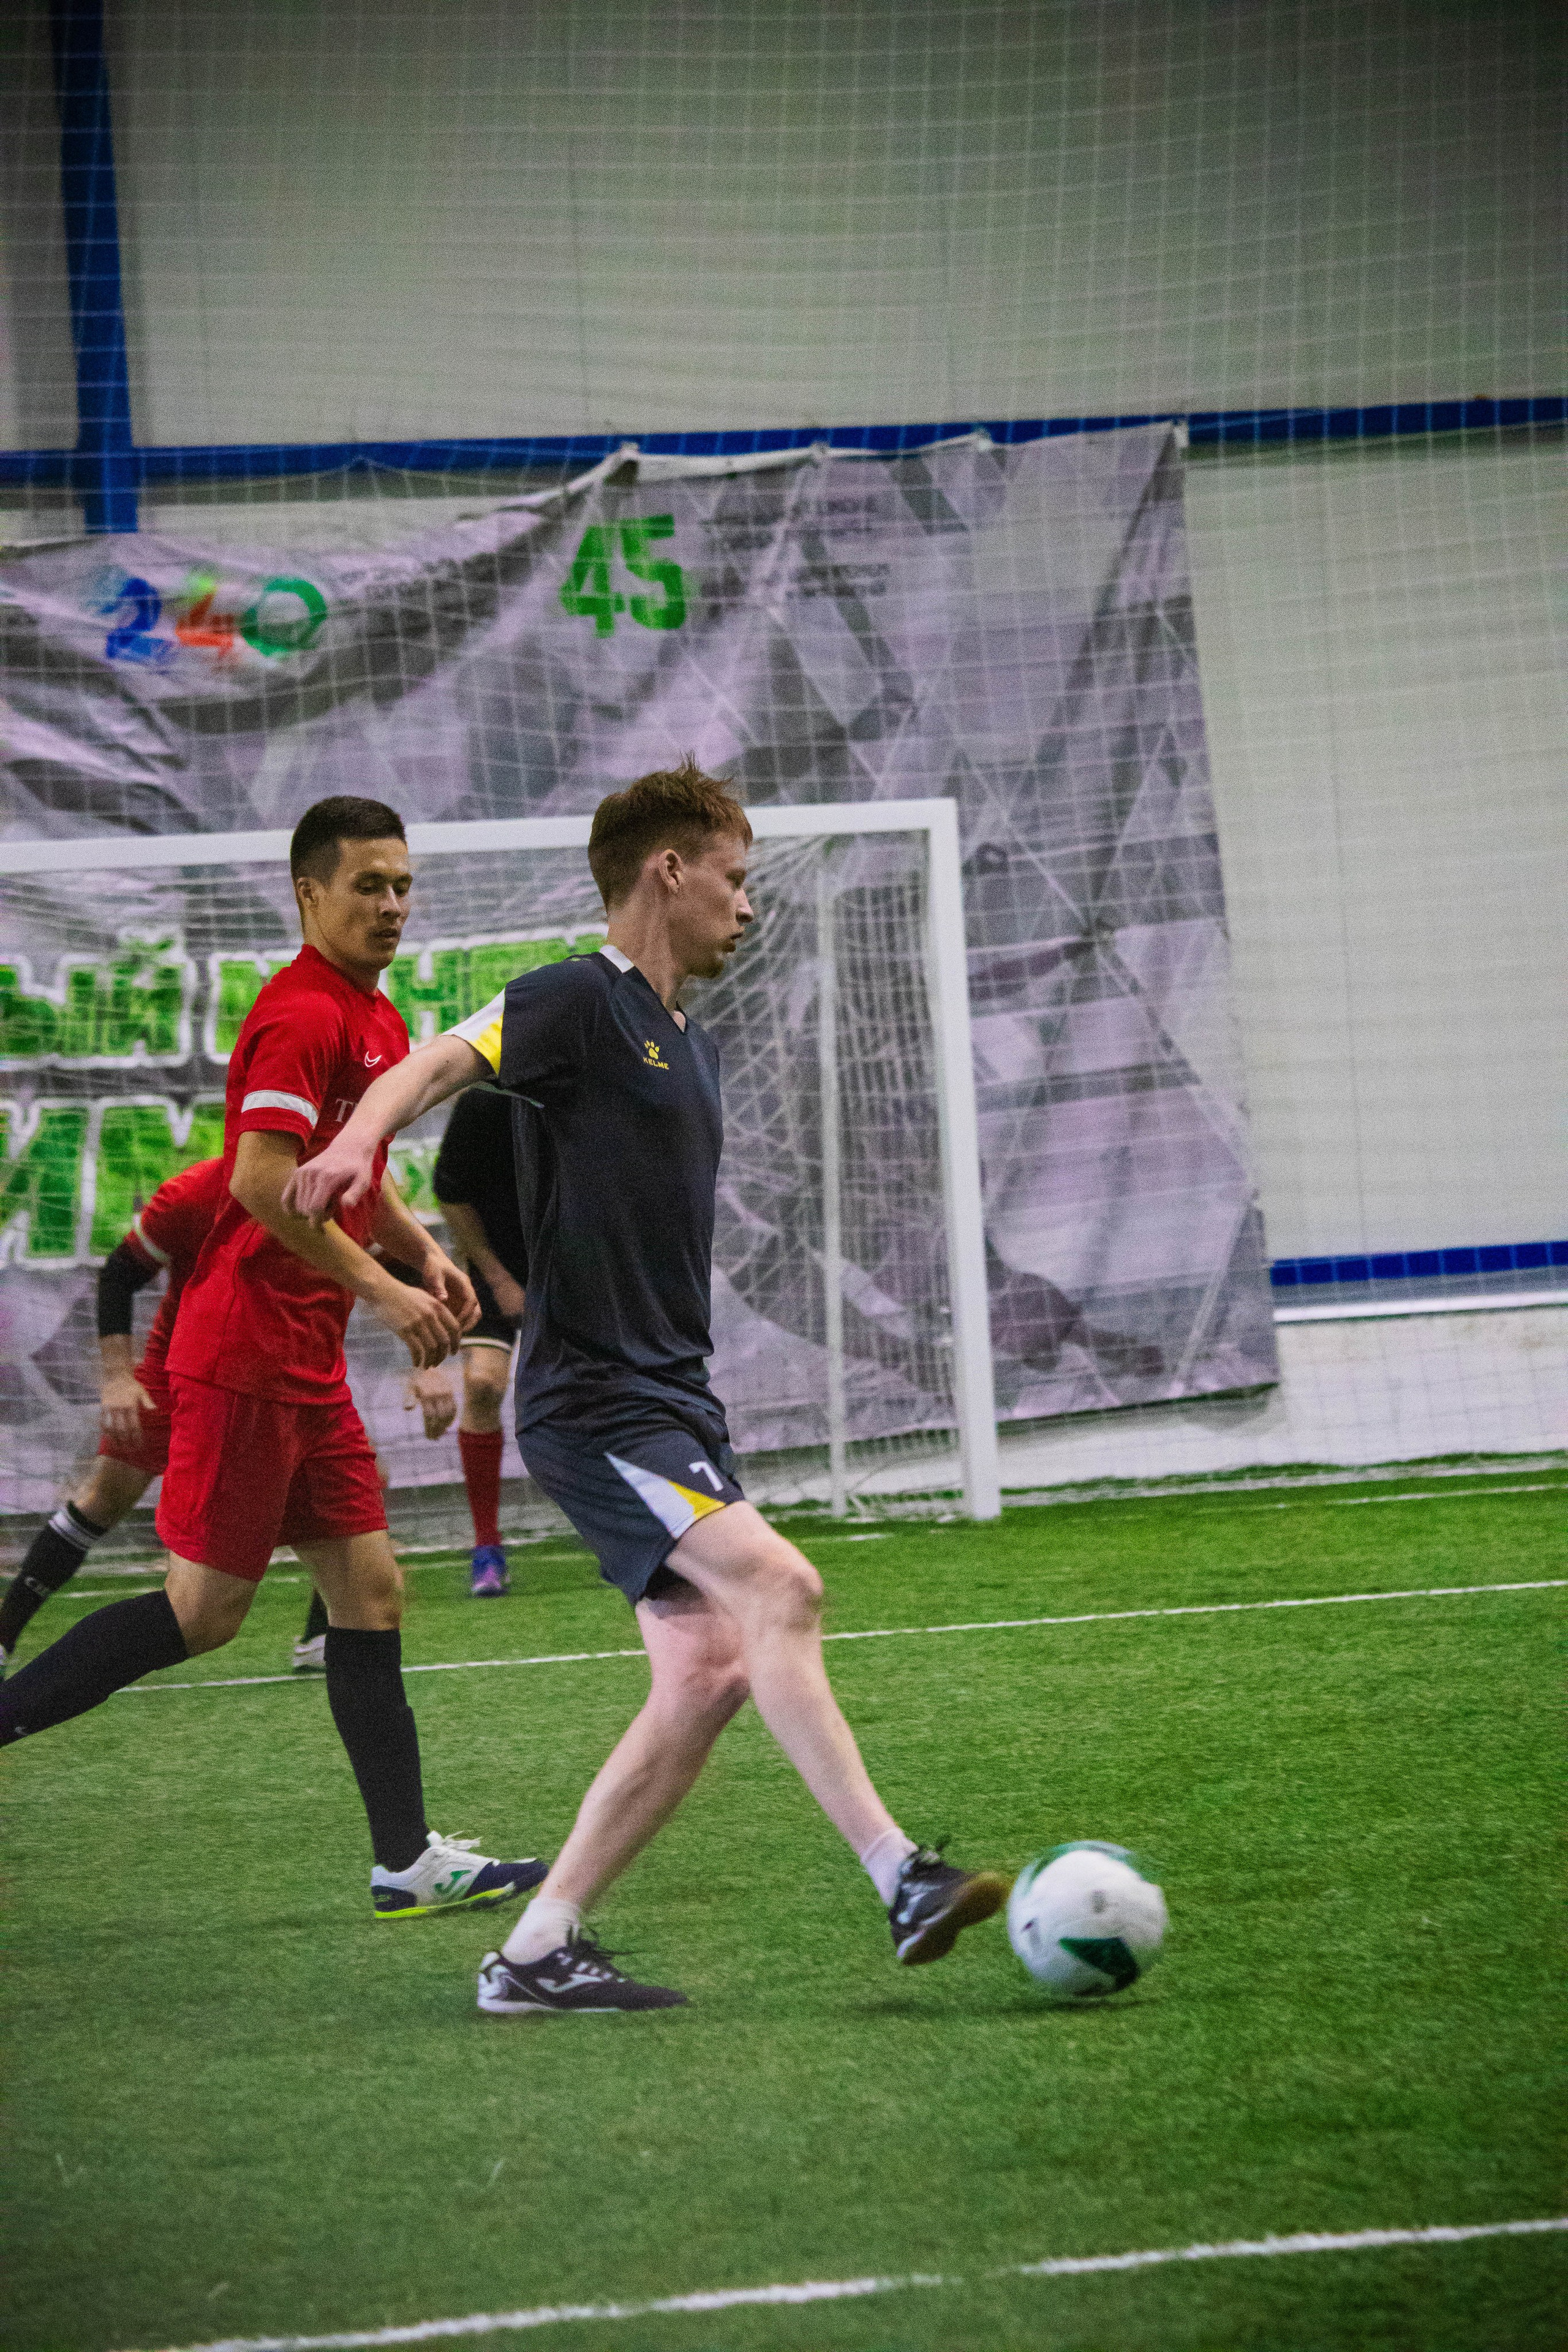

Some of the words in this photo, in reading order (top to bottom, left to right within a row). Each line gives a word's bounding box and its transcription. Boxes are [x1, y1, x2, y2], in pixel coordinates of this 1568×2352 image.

[560, 514, 686, 638] 45
[643, 1057, 669, 1070] KELME
[688, 1462, 723, 1492] 7
